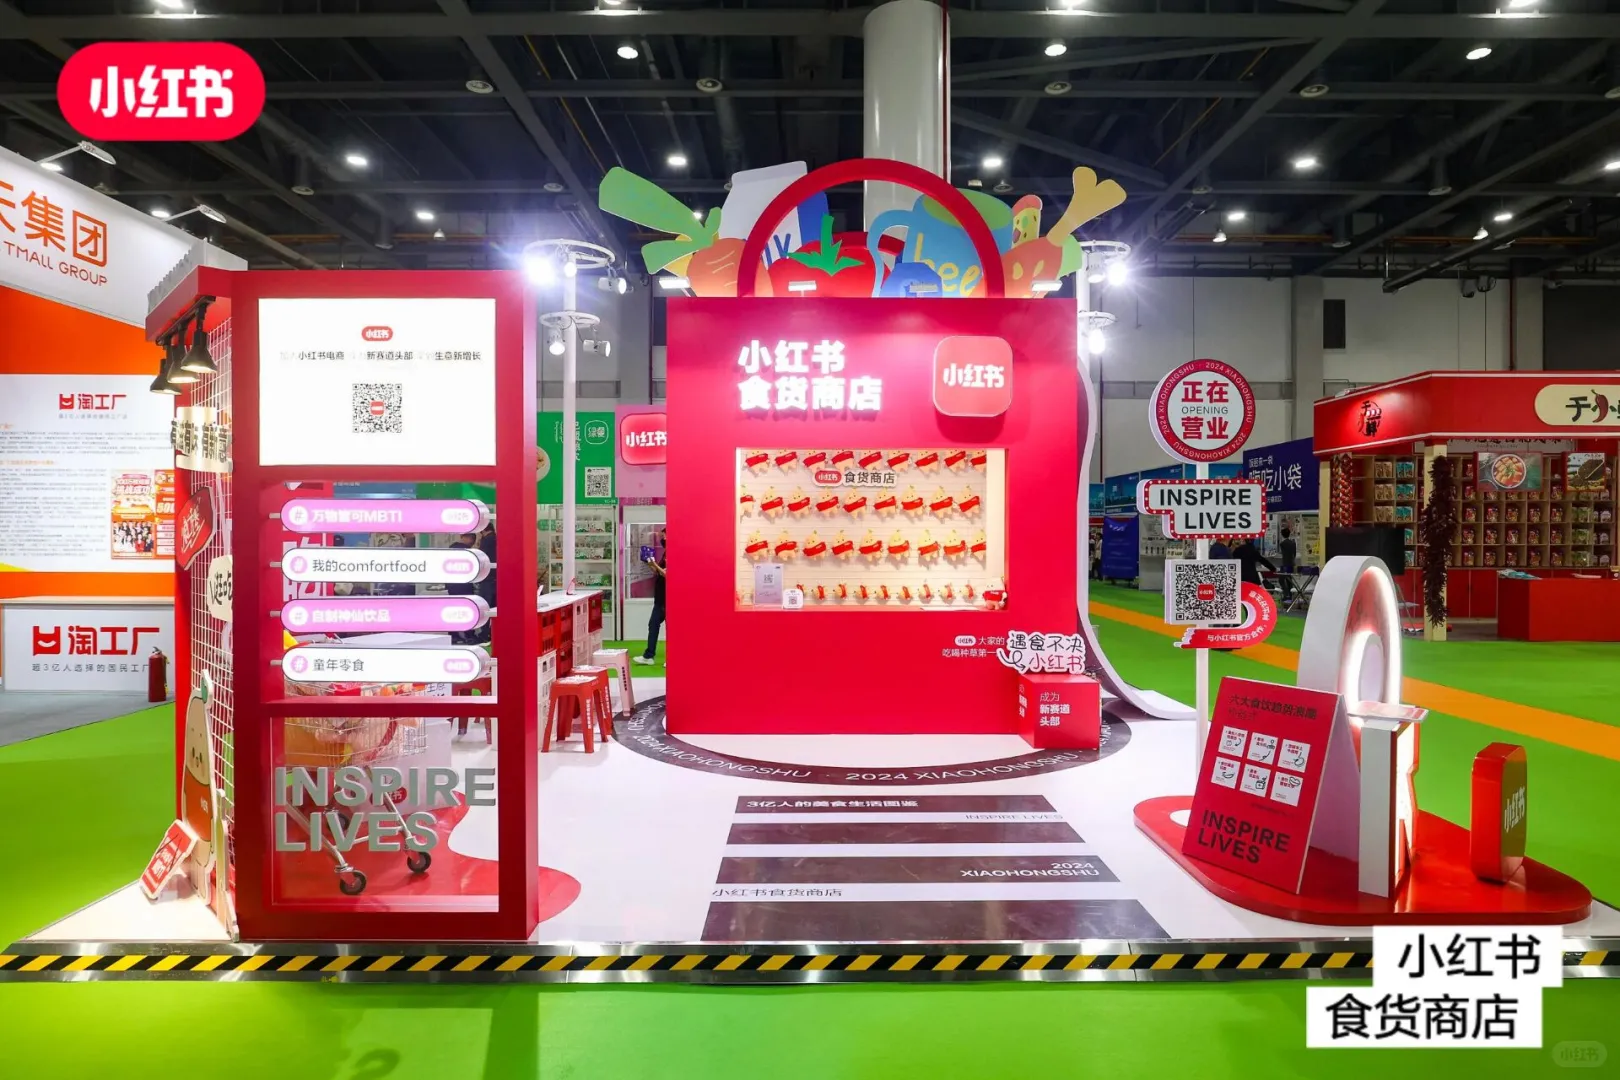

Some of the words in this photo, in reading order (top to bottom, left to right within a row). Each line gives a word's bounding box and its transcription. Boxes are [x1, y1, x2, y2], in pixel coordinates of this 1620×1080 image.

[58, 261, 108, 287] GROUP
[738, 340, 846, 374] 小红书
[943, 362, 1005, 388] 小红书
[738, 376, 883, 412] 食货商店
[1181, 380, 1229, 403] 正在
[78, 394, 127, 410] 淘工厂
[1181, 406, 1228, 414] OPENING
[1181, 416, 1229, 440] 营业
[625, 431, 667, 447] 小红书
[844, 471, 895, 484] 食货商店
[1159, 488, 1252, 506] INSPIRE
[1184, 512, 1252, 529] LIVES
[312, 558, 426, 573] 我的comfortfood
[67, 626, 160, 656] 淘工厂
[978, 636, 1005, 646] 大家的
[1009, 632, 1083, 653] 遇食不决
[312, 658, 365, 672] 童年零食
[1028, 653, 1083, 672] 小红书
[1040, 692, 1060, 702] 成为
[1040, 704, 1070, 714] 新赛道
[1040, 717, 1060, 726] 头部
[845, 773, 908, 781] 2024
[275, 766, 496, 807] INSPIRE
[1504, 786, 1525, 833] 小红书
[275, 811, 439, 852] LIVES
[1203, 809, 1291, 852] INSPIRE
[1199, 829, 1260, 864] LIVES
[712, 888, 842, 897] 小红书食货商店
